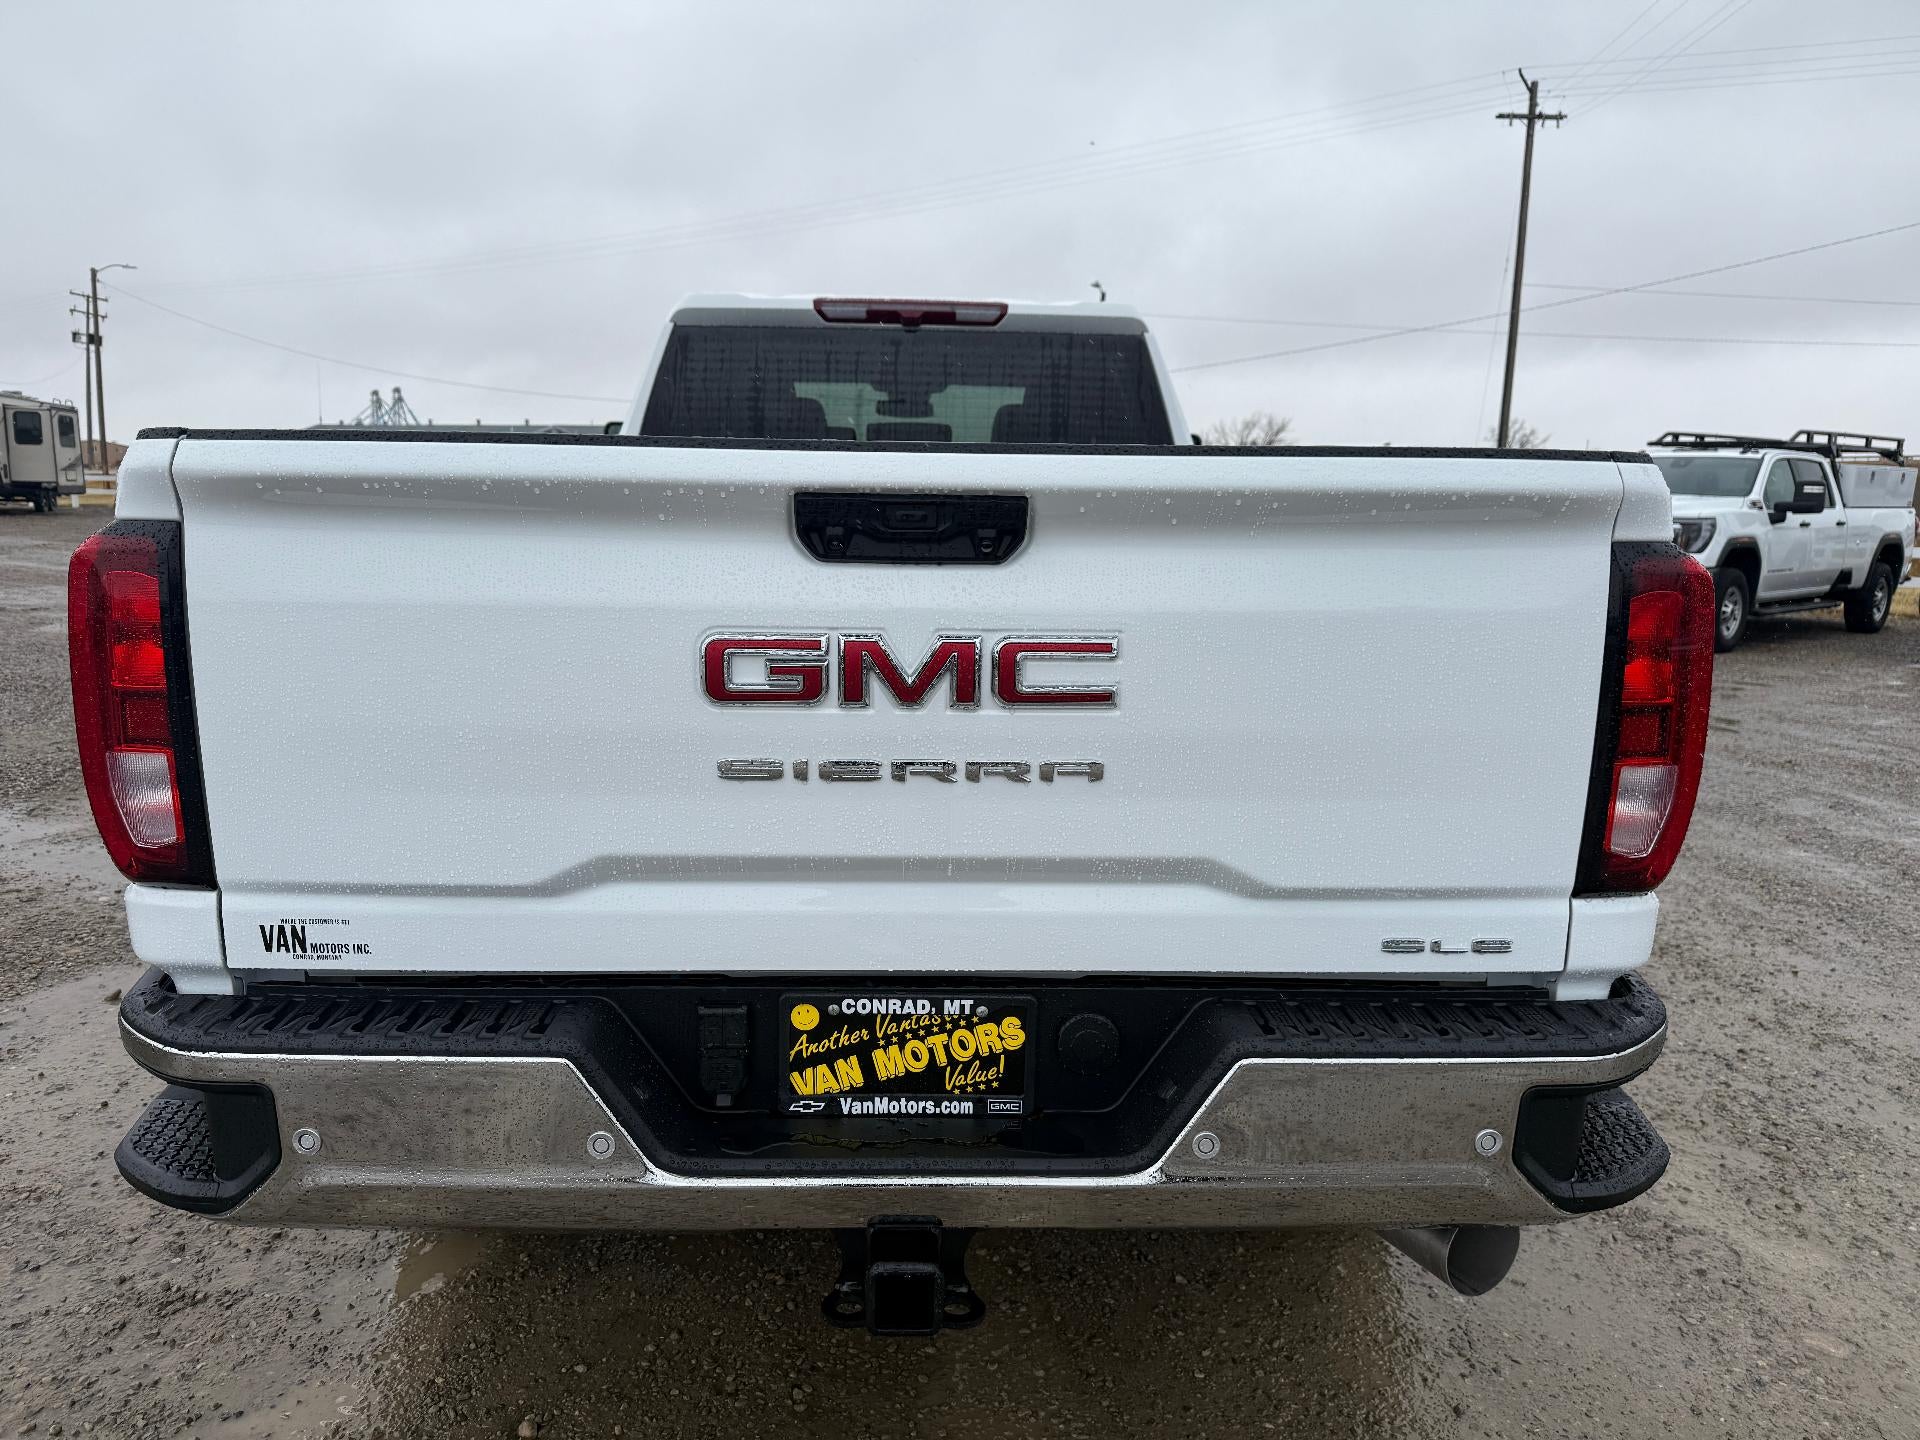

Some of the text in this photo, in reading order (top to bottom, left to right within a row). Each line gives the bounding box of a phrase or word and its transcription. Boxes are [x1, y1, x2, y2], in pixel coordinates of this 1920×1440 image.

[700, 632, 1119, 709] GMC
[717, 758, 1105, 783] SIERRA
[259, 925, 372, 955] VAN MOTORS INC.
[841, 998, 975, 1016] CONRAD, MT
[789, 1014, 965, 1063] Another Vantas
[790, 1016, 1026, 1095] VAN MOTORS
[945, 1054, 1005, 1091] Value!
[839, 1097, 974, 1115] VanMotors.com
[990, 1102, 1020, 1111] GMC
